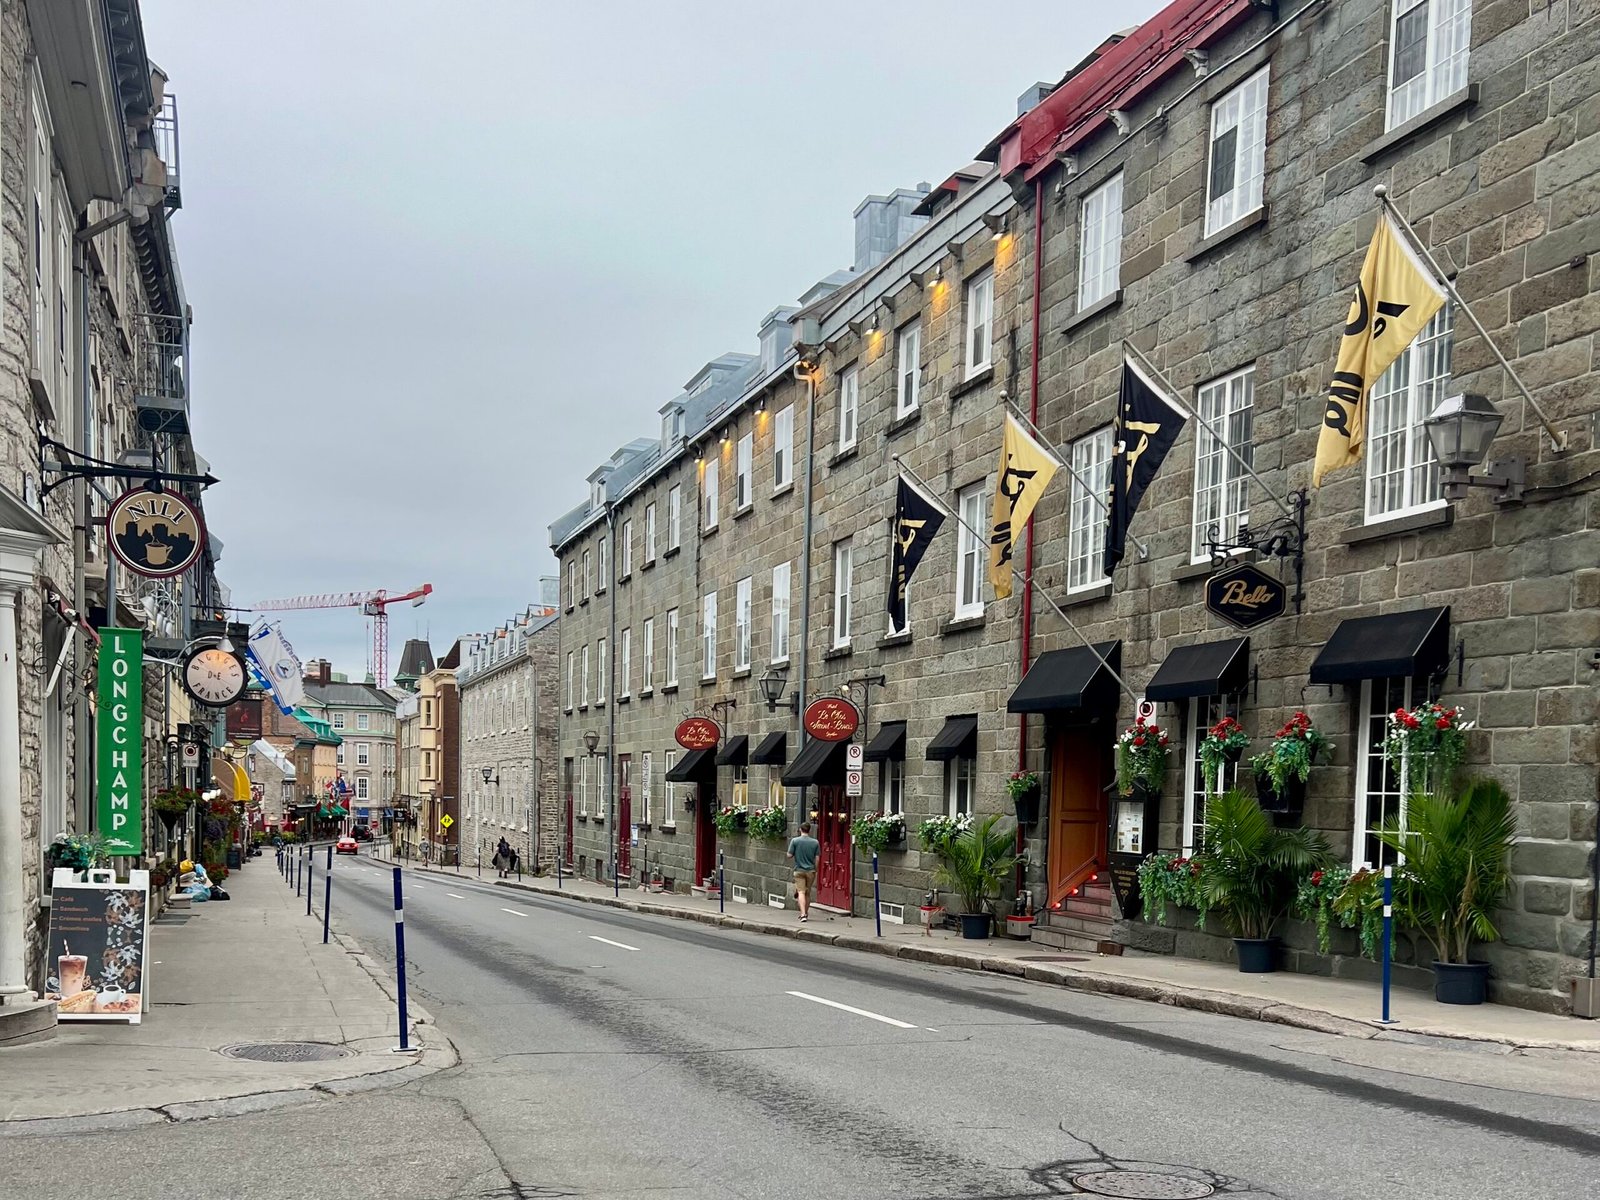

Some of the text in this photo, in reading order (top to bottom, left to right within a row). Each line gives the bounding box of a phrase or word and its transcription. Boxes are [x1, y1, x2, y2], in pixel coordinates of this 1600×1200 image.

[125, 498, 190, 526] NILI
[1219, 579, 1276, 609] Bello
[191, 653, 240, 679] BAGAGES
[192, 682, 234, 700] FRANCE
[111, 635, 130, 832] LONGCHAMP
